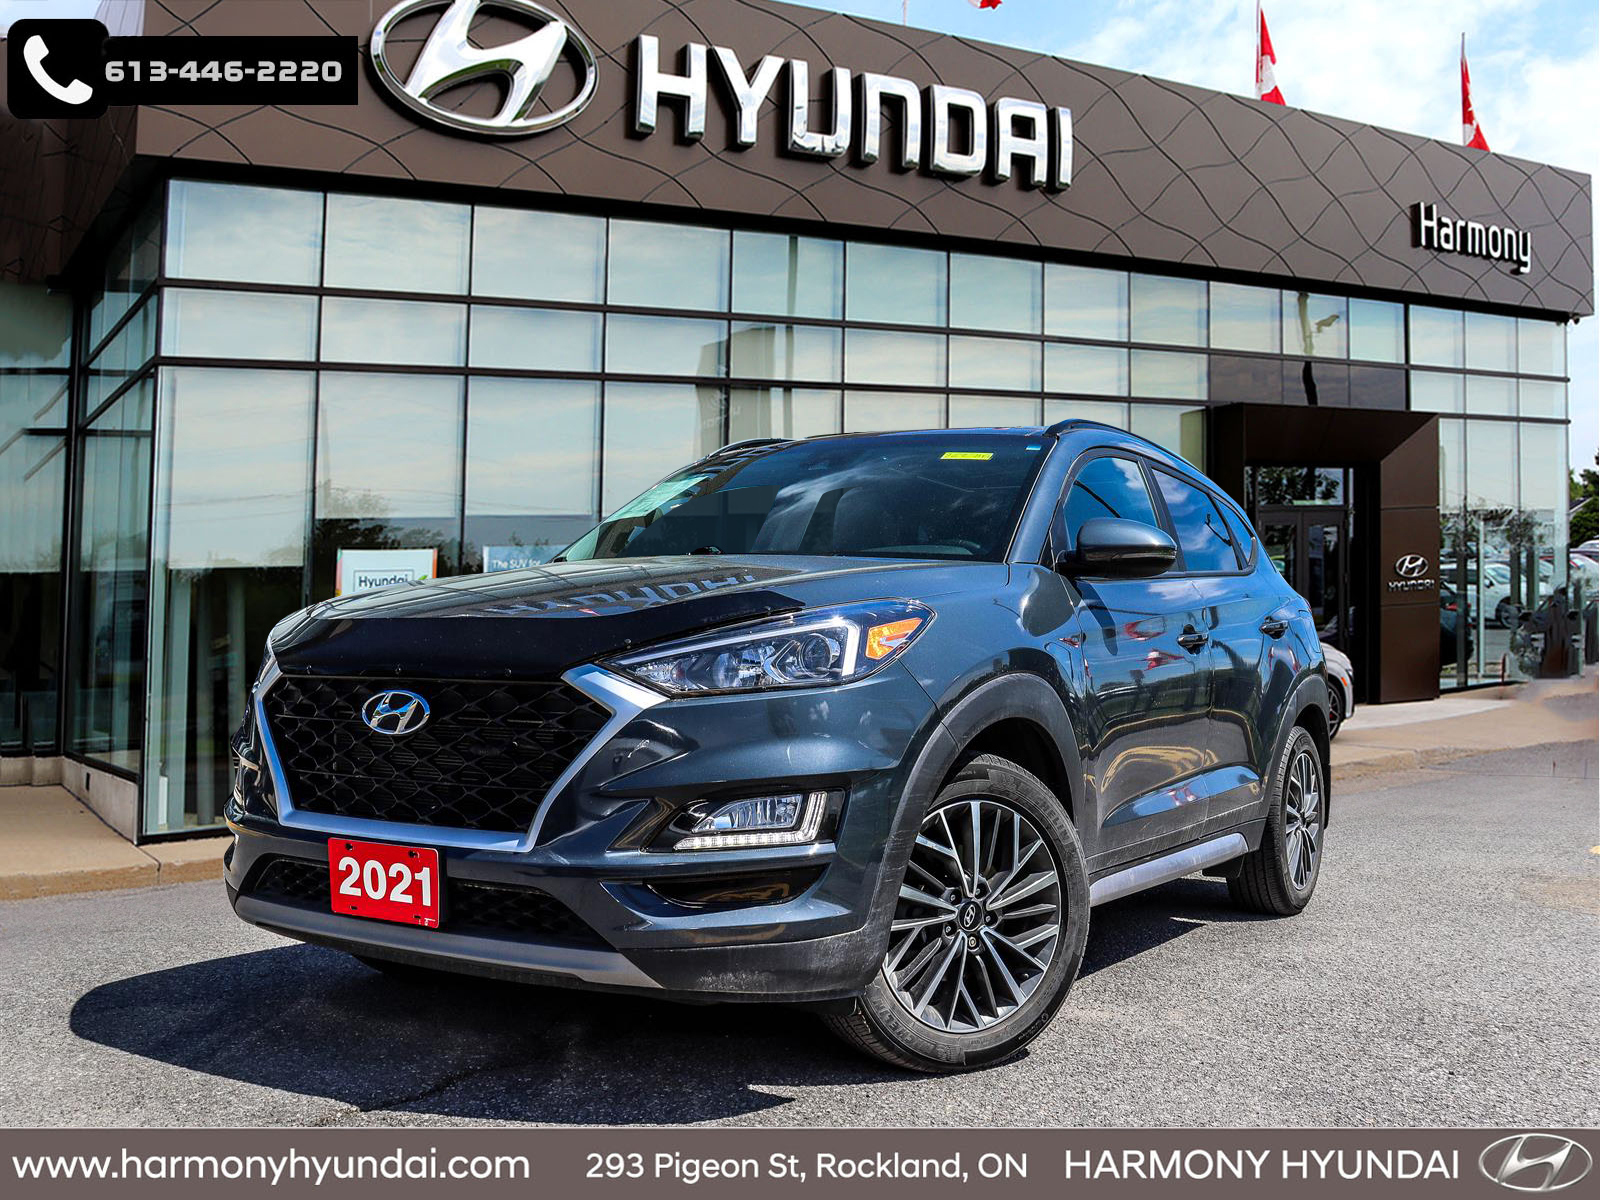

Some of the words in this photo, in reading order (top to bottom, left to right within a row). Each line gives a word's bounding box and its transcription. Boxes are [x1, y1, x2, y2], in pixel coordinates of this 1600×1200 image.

[636, 34, 1074, 191] HYUNDAI
[1417, 202, 1531, 273] Harmony
[509, 559, 527, 569] SUV
[1388, 579, 1435, 591] HYUNDAI
[338, 856, 431, 907] 2021
